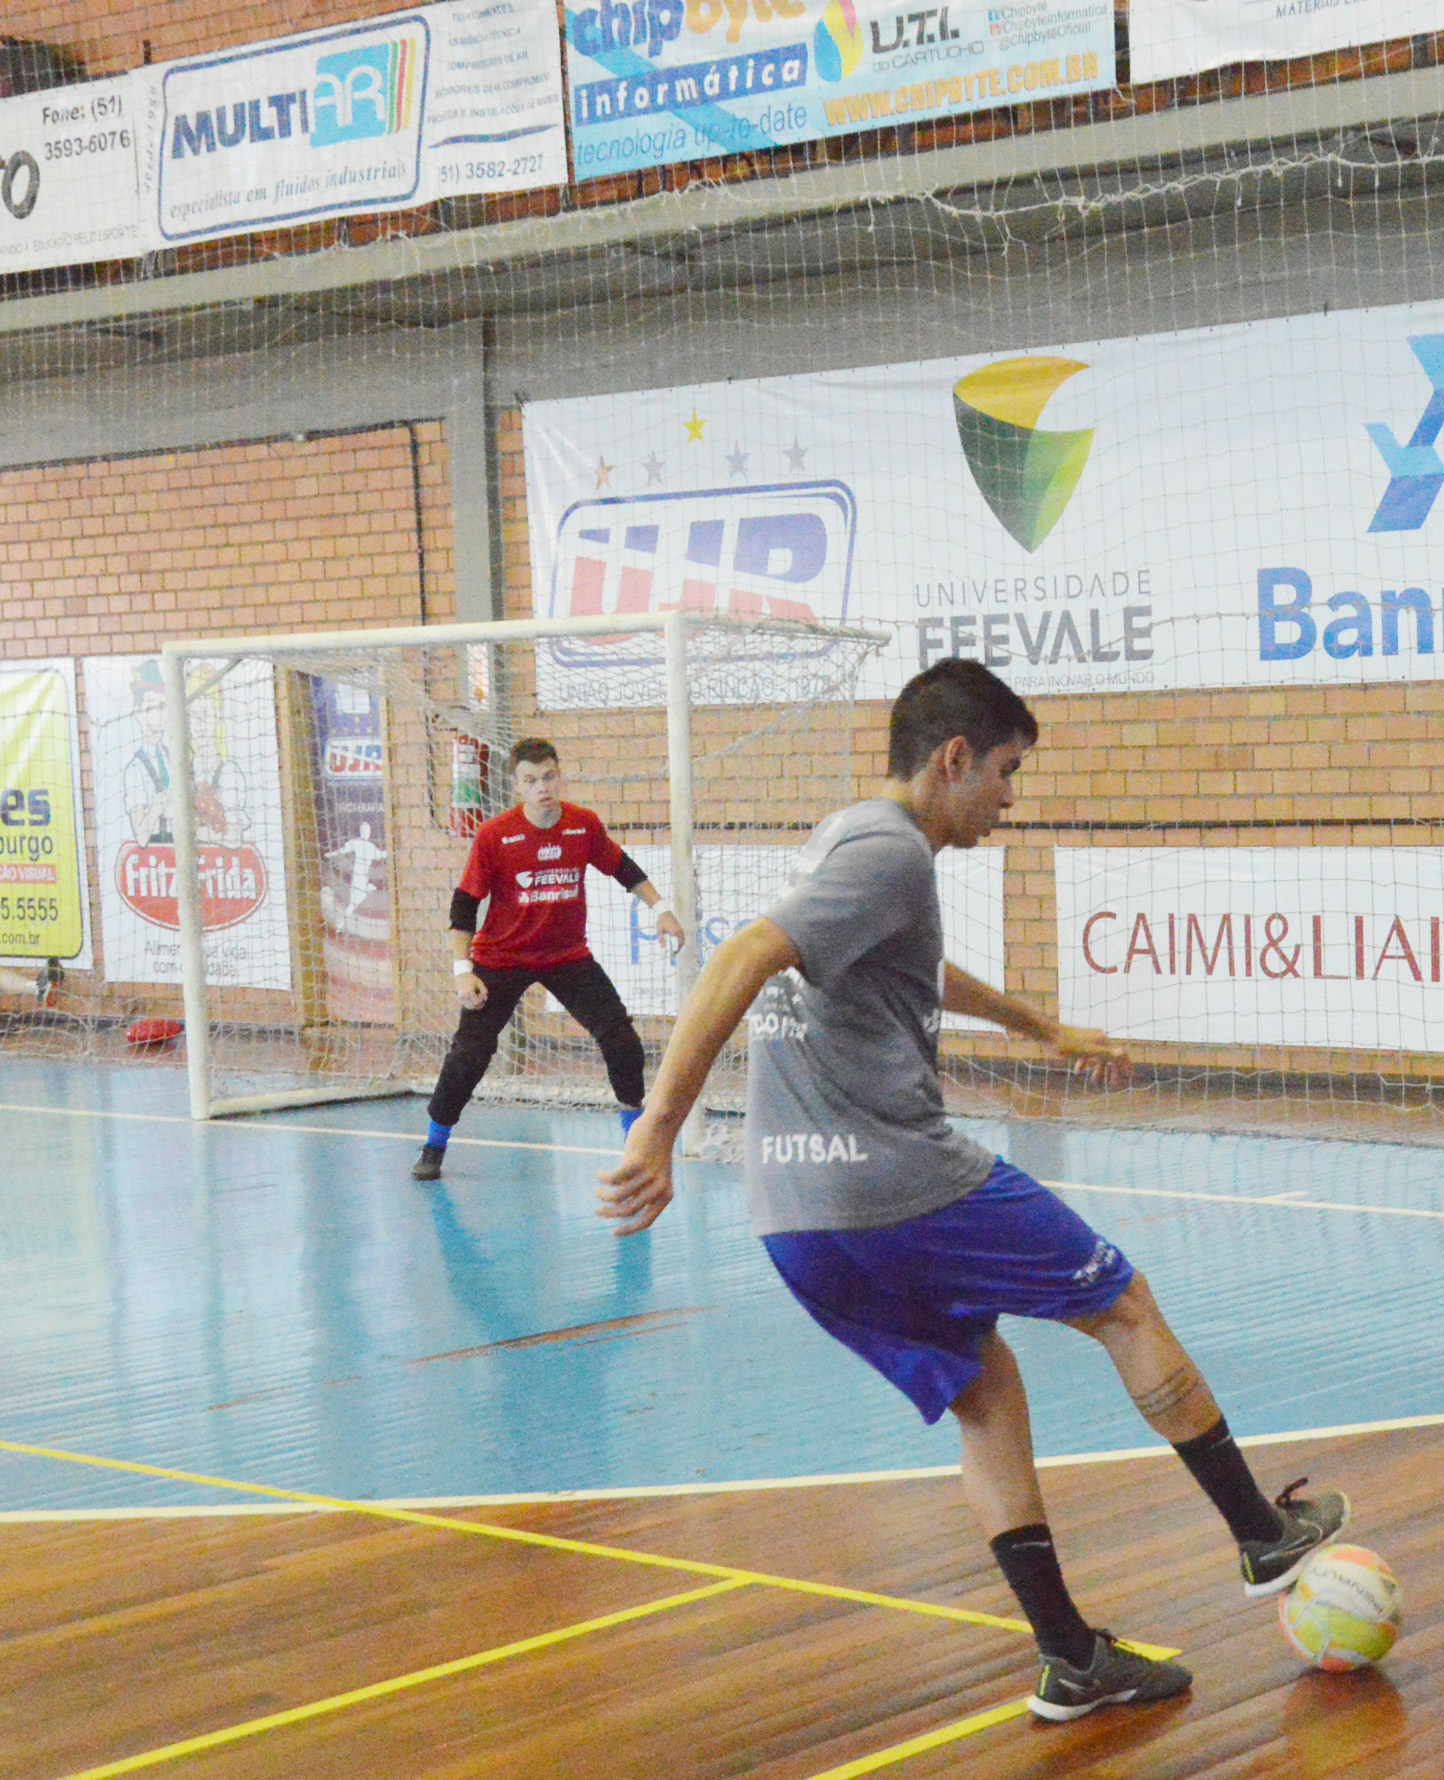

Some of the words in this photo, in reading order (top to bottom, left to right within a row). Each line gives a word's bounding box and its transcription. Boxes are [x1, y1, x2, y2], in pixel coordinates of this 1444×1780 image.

[892, 40, 985, 69] CARTUCHO
[580, 58, 800, 119] informática
[822, 51, 1099, 127] WWW.CHIPBYTE.COM.BR
[42, 105, 86, 125] Fone:
[91, 94, 122, 121] (51)
[44, 129, 131, 161] 3593-6076
[577, 124, 687, 165] tecnologia
[465, 154, 544, 180] 3582-2727
[169, 189, 241, 222] especialista
[246, 186, 267, 202] em
[273, 178, 321, 204] fluidos
[324, 160, 407, 189] industriais
[916, 569, 1150, 607] UNIVERSIDADE
[917, 605, 1155, 671] FEEVALE
[1014, 674, 1046, 689] PARA
[1049, 673, 1093, 688] INOVAR
[1109, 671, 1156, 685] MUNDO
[19, 865, 55, 881] VISUAL
[535, 873, 580, 887] FEEVALE
[530, 884, 579, 903] Banrisul
[153, 961, 174, 975] com
[761, 1132, 869, 1164] FUTSAL
